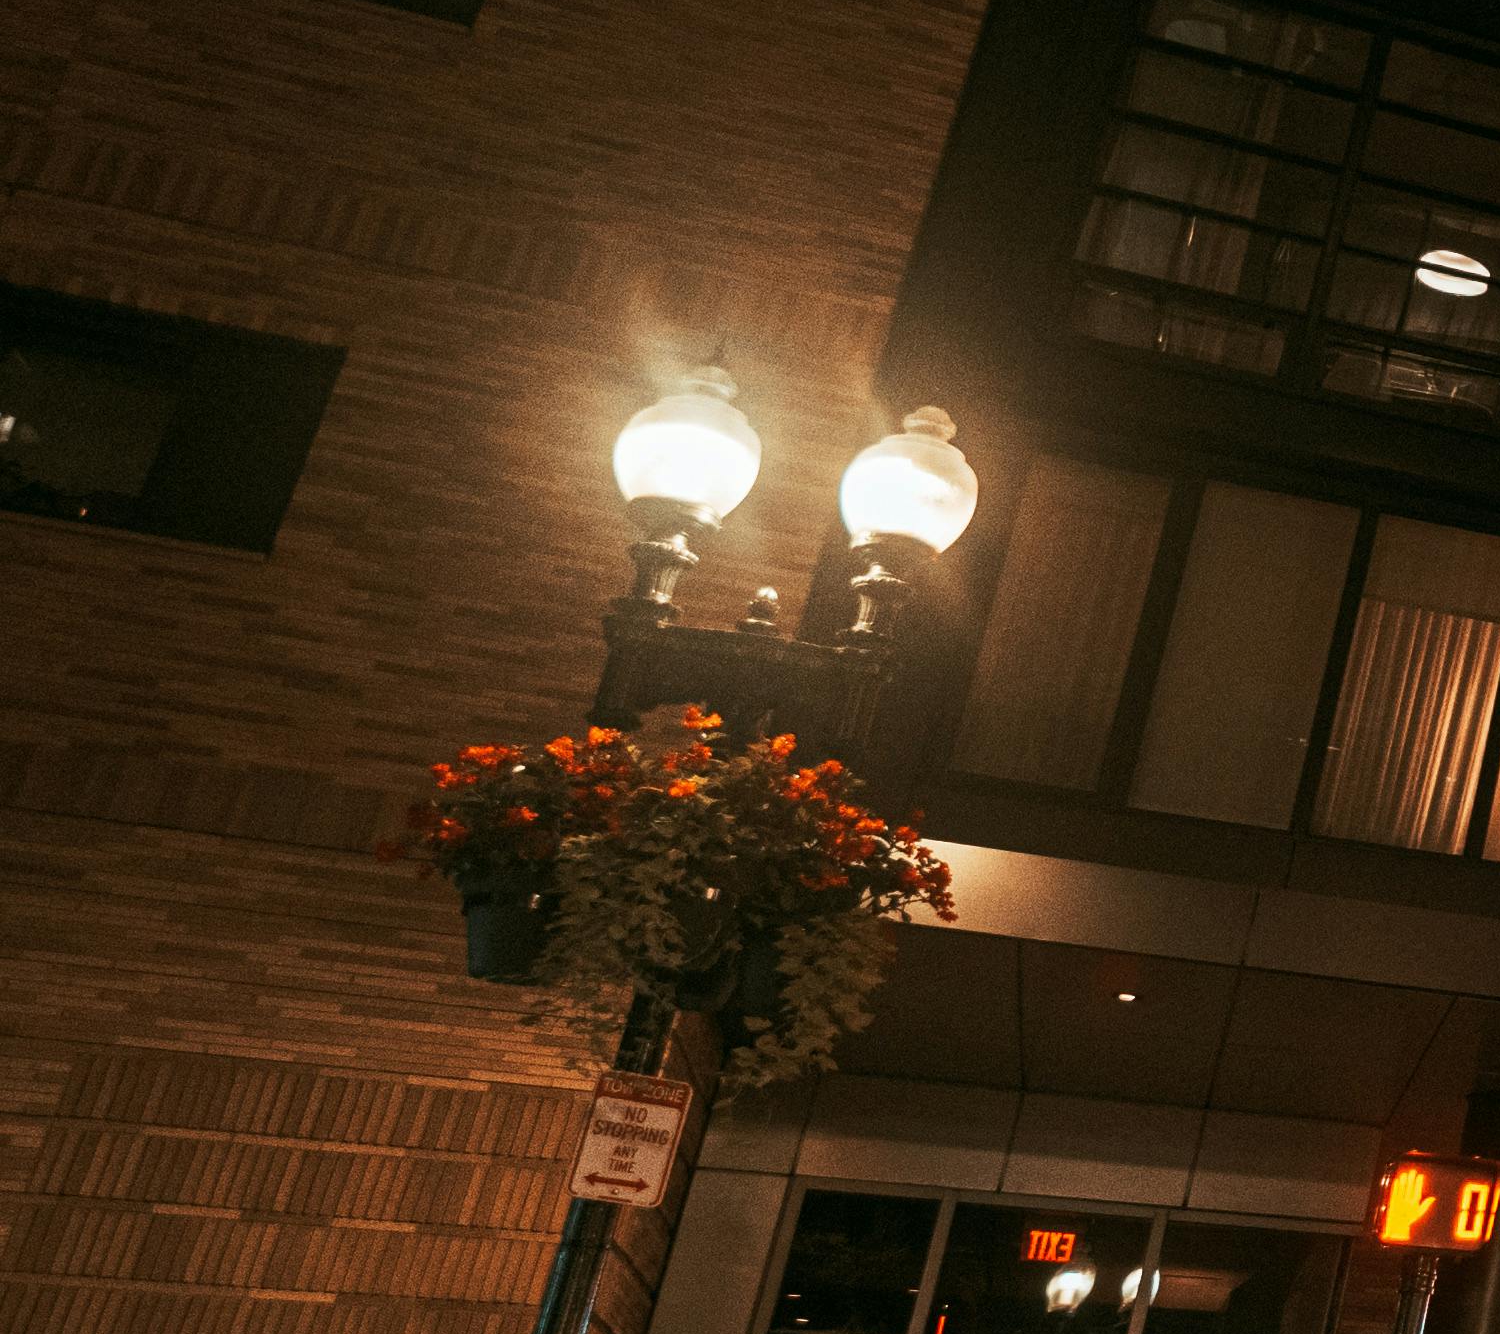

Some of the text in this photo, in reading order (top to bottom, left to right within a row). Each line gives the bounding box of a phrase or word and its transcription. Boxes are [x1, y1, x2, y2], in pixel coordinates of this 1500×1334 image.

[625, 1107, 648, 1123] NO
[592, 1119, 671, 1146] STOPPING
[613, 1146, 639, 1158] ANY
[608, 1158, 636, 1173] TIME
